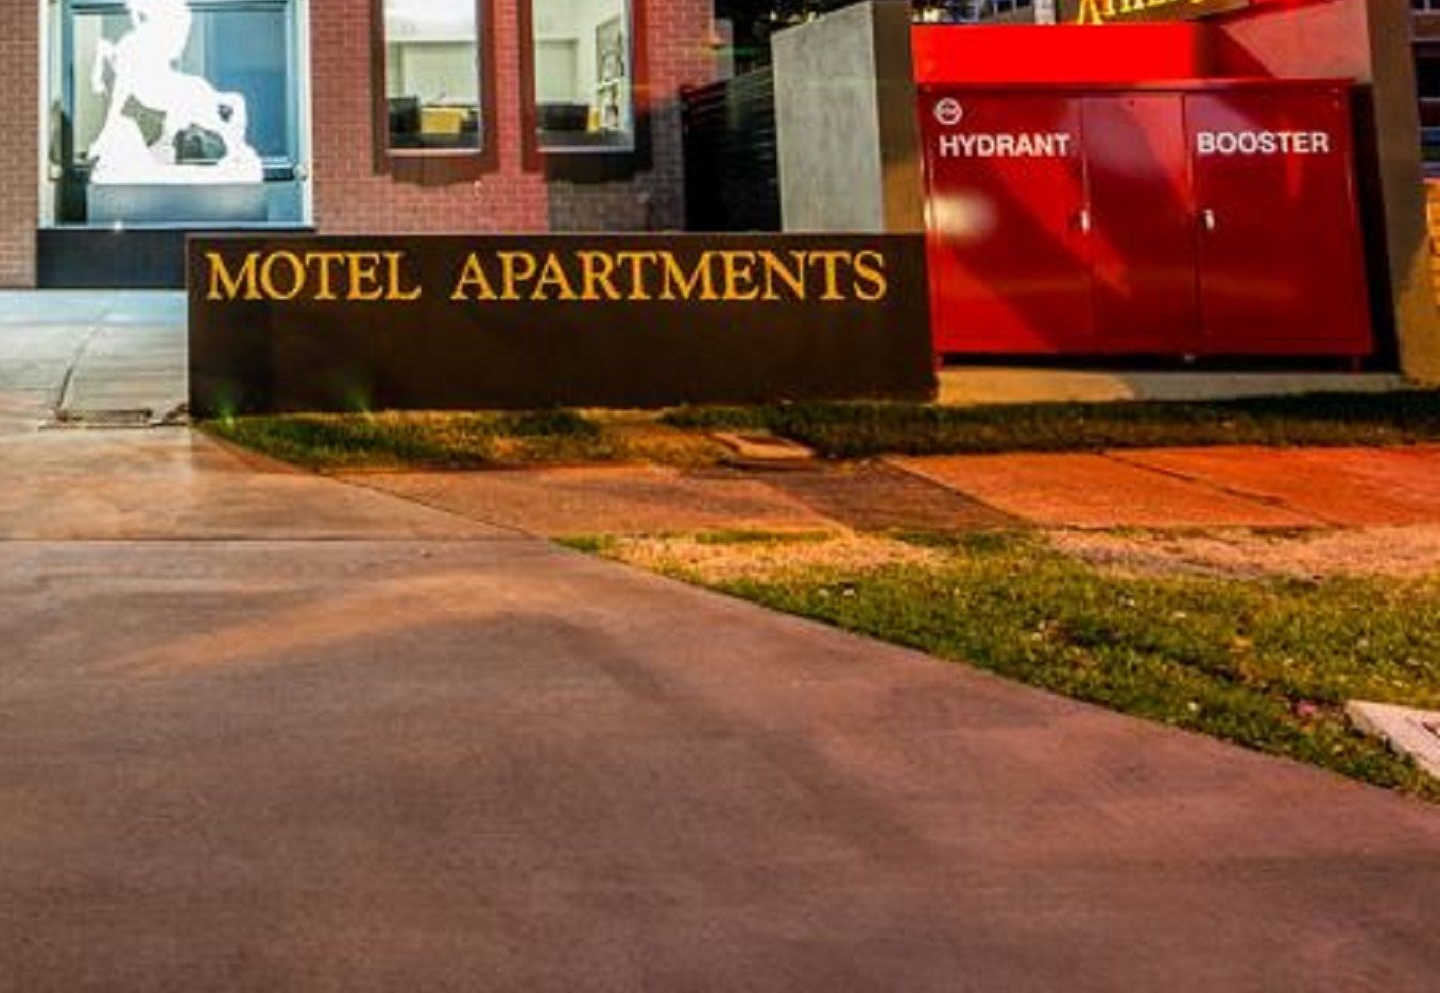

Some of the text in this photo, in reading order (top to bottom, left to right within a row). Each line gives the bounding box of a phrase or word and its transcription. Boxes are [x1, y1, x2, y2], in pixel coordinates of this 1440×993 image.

[939, 131, 1330, 157] HYDRANT BOOSTER
[206, 250, 888, 301] MOTEL APARTMENTS
